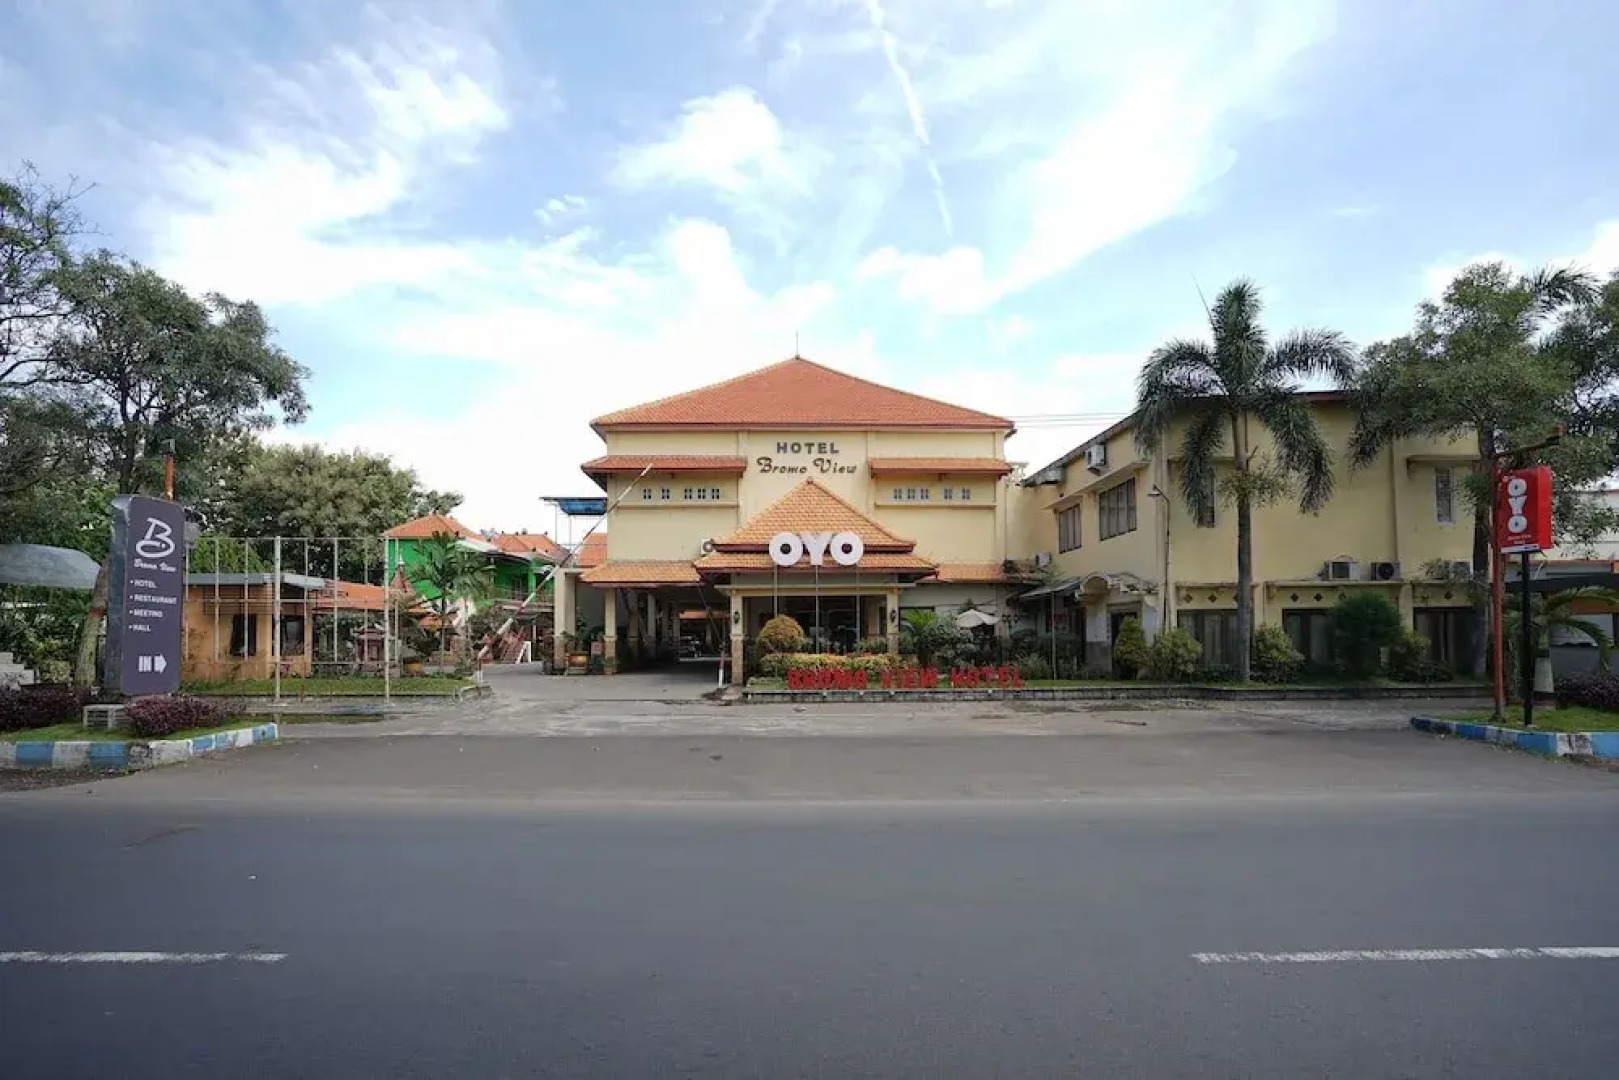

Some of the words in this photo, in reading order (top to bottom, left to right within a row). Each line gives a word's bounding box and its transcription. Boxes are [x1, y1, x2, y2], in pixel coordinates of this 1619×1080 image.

[776, 442, 840, 454] HOTEL
[757, 456, 808, 473] Bromo
[813, 457, 857, 474] View
[1507, 478, 1528, 533] OYO
[768, 532, 864, 566] OYO
[134, 580, 157, 588] HOTEL
[134, 594, 177, 604] RESTAURANT
[134, 609, 163, 617] MEETING
[133, 624, 151, 633] HALL
[139, 655, 152, 673] IN
